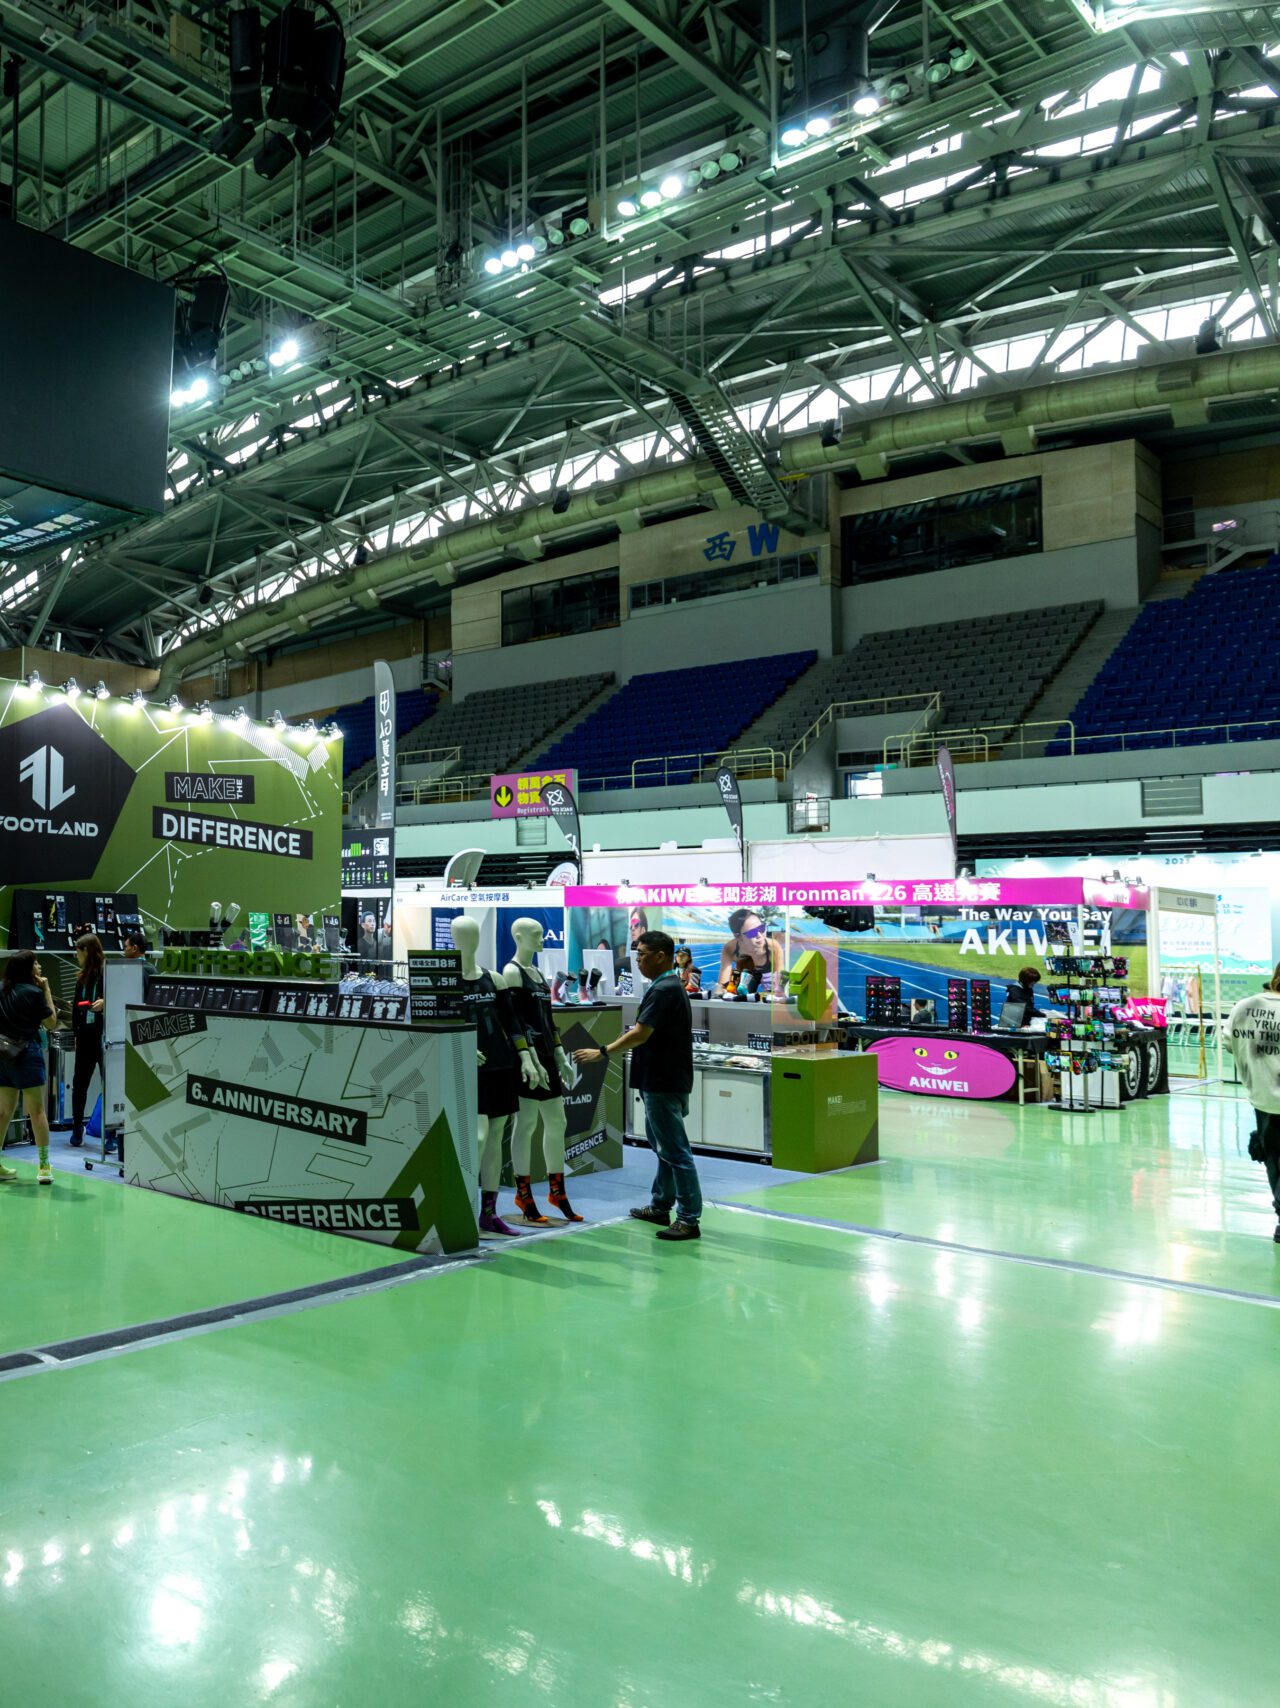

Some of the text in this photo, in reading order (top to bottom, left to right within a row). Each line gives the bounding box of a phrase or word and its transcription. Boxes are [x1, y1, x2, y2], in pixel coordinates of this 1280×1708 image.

[703, 523, 779, 562] 西 W
[173, 775, 244, 802] MAKE THE
[517, 807, 550, 815] Registrati
[162, 813, 301, 857] DIFFERENCE
[441, 894, 468, 902] AirCare
[783, 886, 864, 902] Ironman
[959, 908, 1113, 923] The Way You Say
[1246, 1008, 1276, 1019] TURN
[136, 1014, 189, 1042] MAKE
[1232, 1028, 1255, 1039] OWN
[908, 1075, 969, 1093] AKIWEI
[563, 1094, 593, 1105] TLAND
[191, 1082, 359, 1137] 6th ANNIVERSARY
[565, 1132, 604, 1161] IFFERENCE
